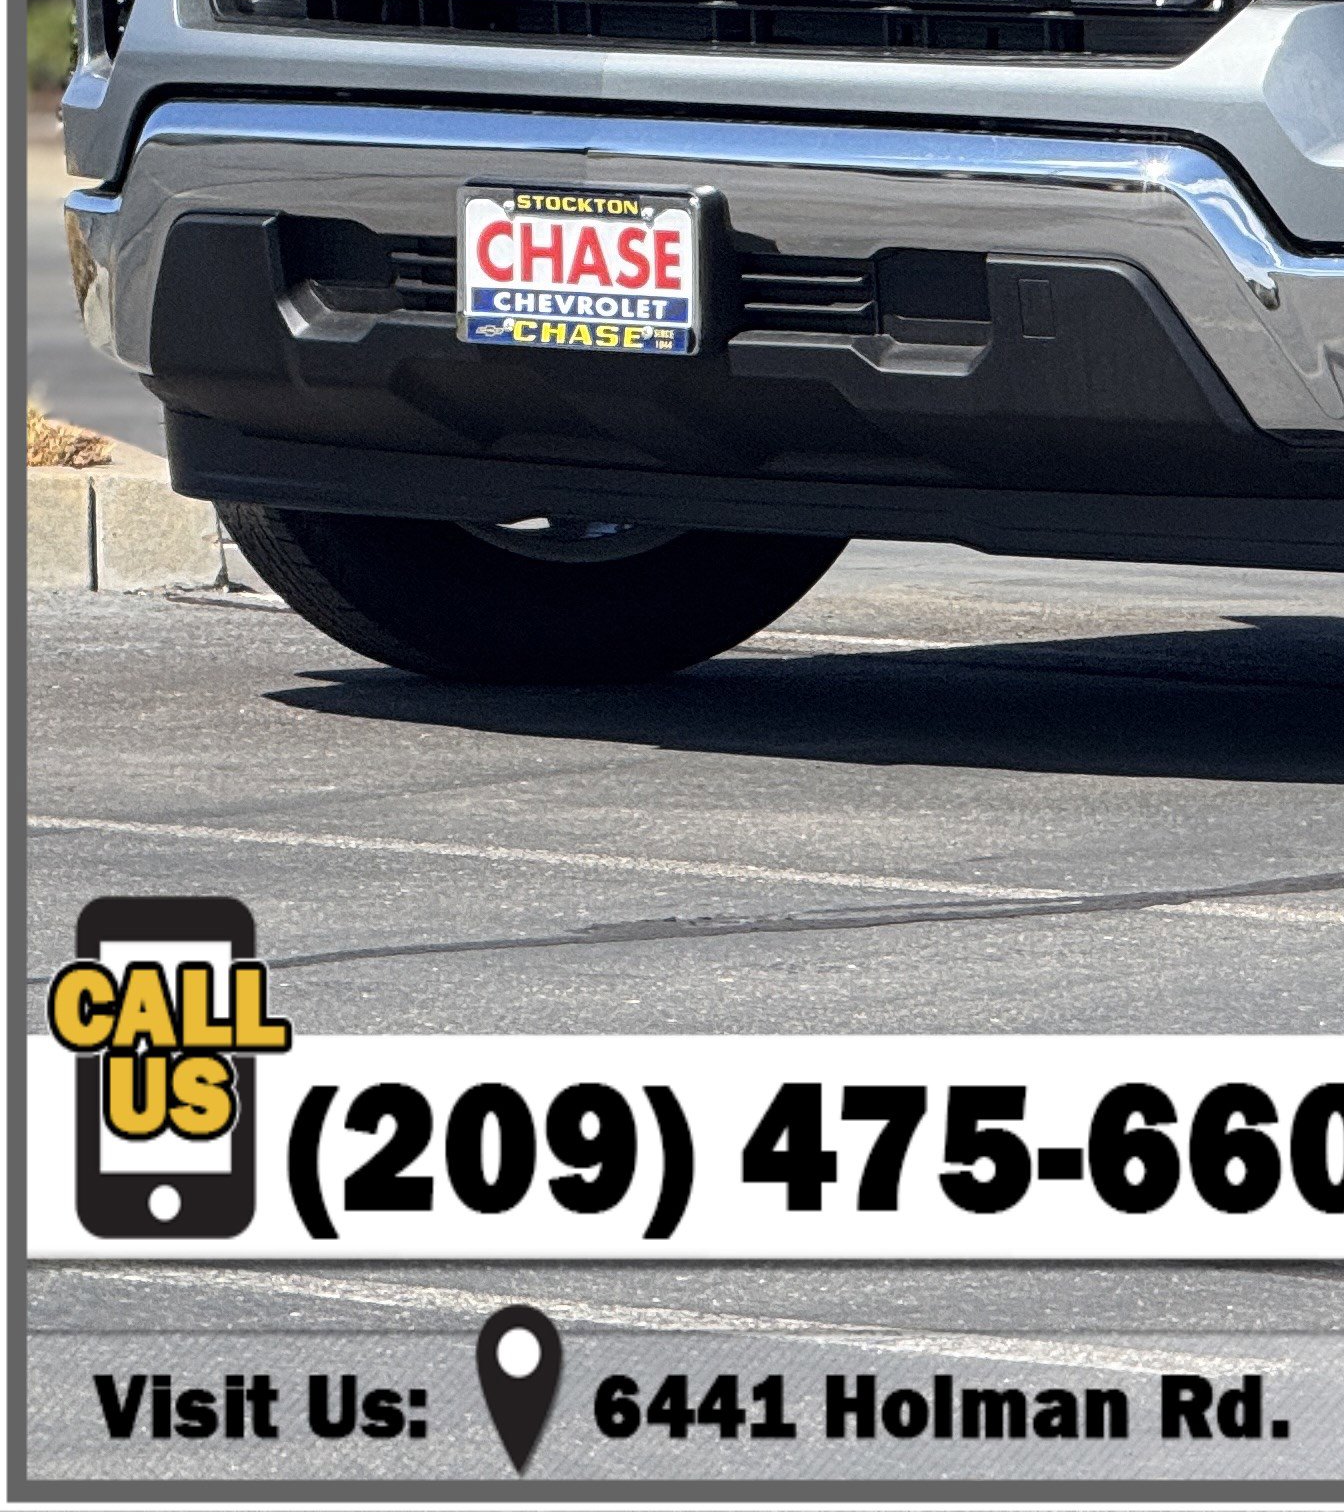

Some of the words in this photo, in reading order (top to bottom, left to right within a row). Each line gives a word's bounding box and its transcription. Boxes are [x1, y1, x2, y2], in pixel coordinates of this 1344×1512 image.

[516, 194, 640, 215] STOCKTON
[476, 220, 681, 290] CHASE
[493, 292, 668, 320] CHEVROLET
[512, 320, 644, 349] CHASE
